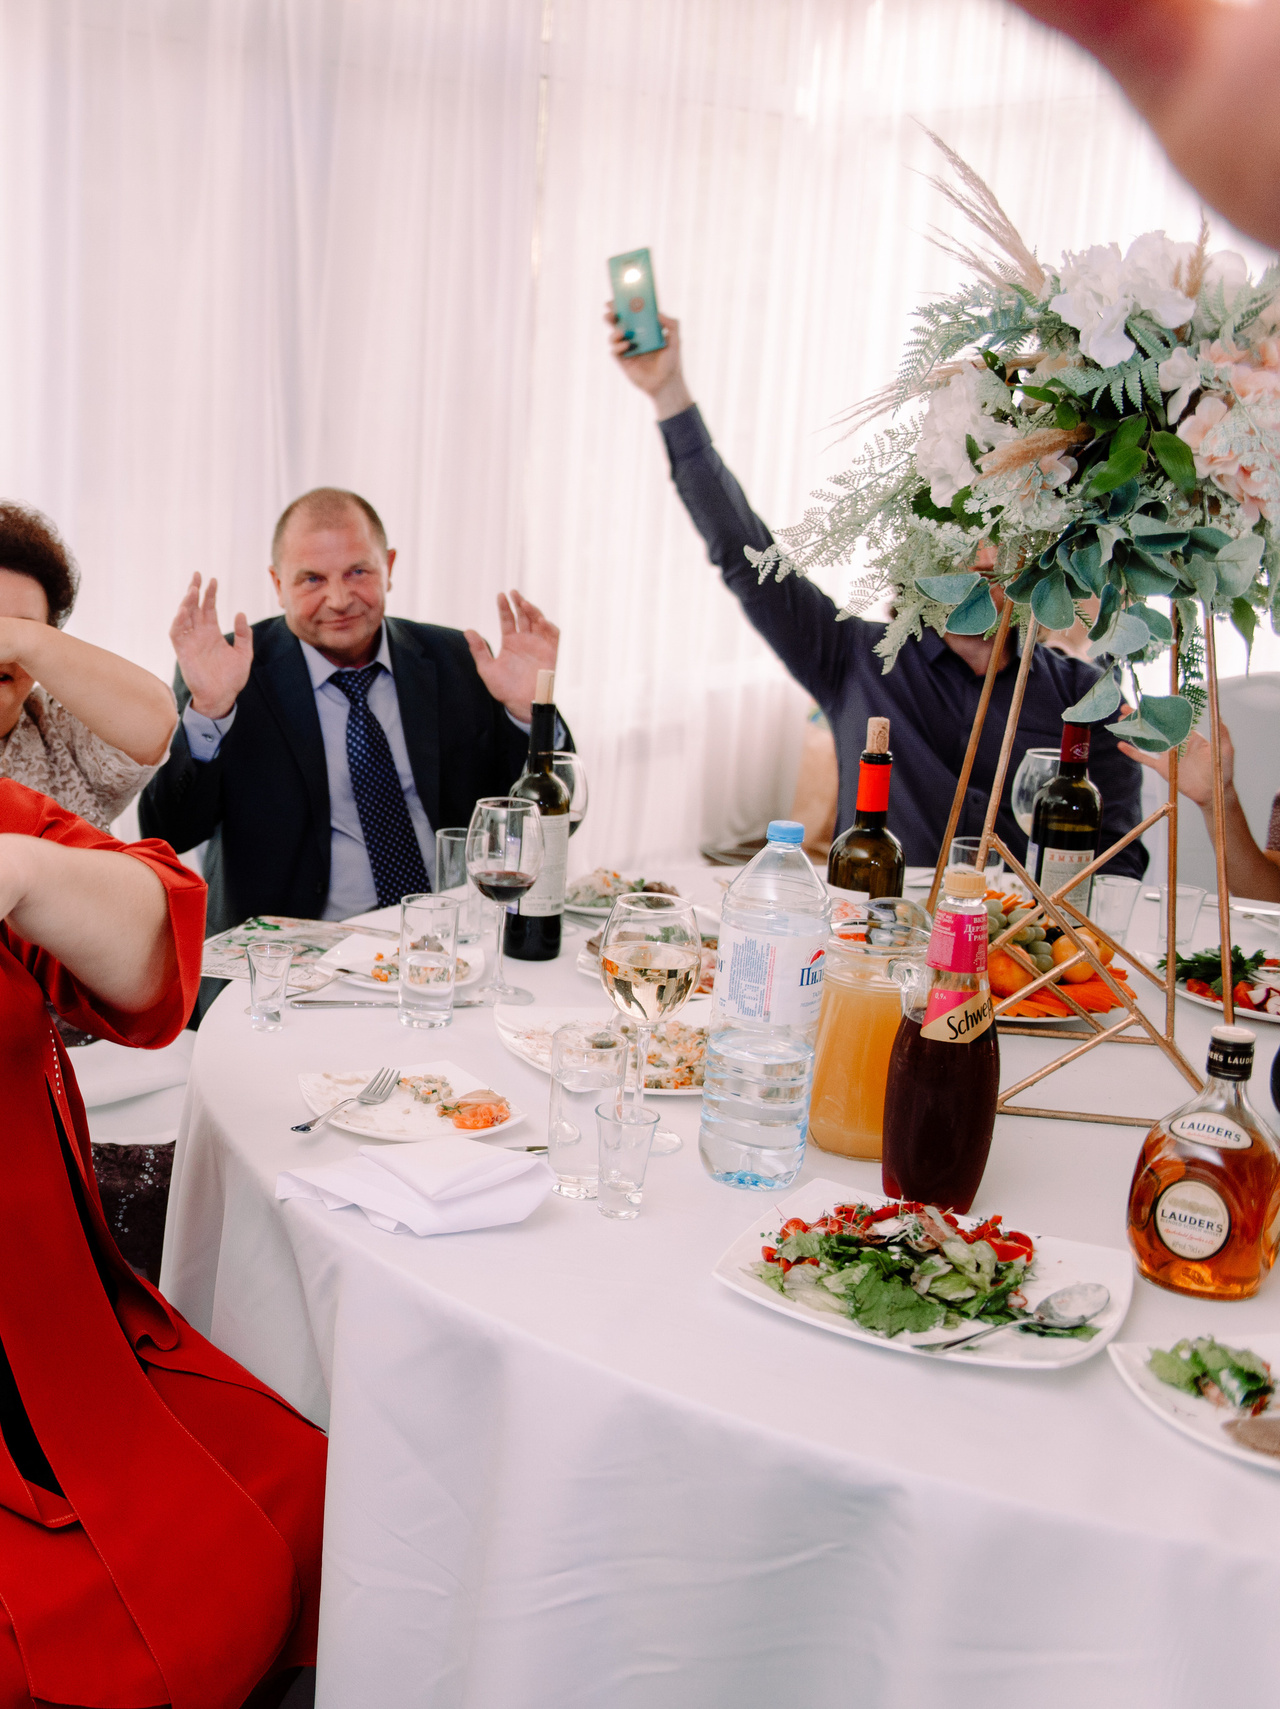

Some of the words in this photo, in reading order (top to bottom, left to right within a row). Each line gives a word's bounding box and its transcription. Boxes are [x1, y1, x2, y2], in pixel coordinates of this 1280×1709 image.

[946, 995, 994, 1041] Schwep
[1180, 1121, 1242, 1143] LAUDER'S
[1161, 1208, 1223, 1232] LAUDER'S
